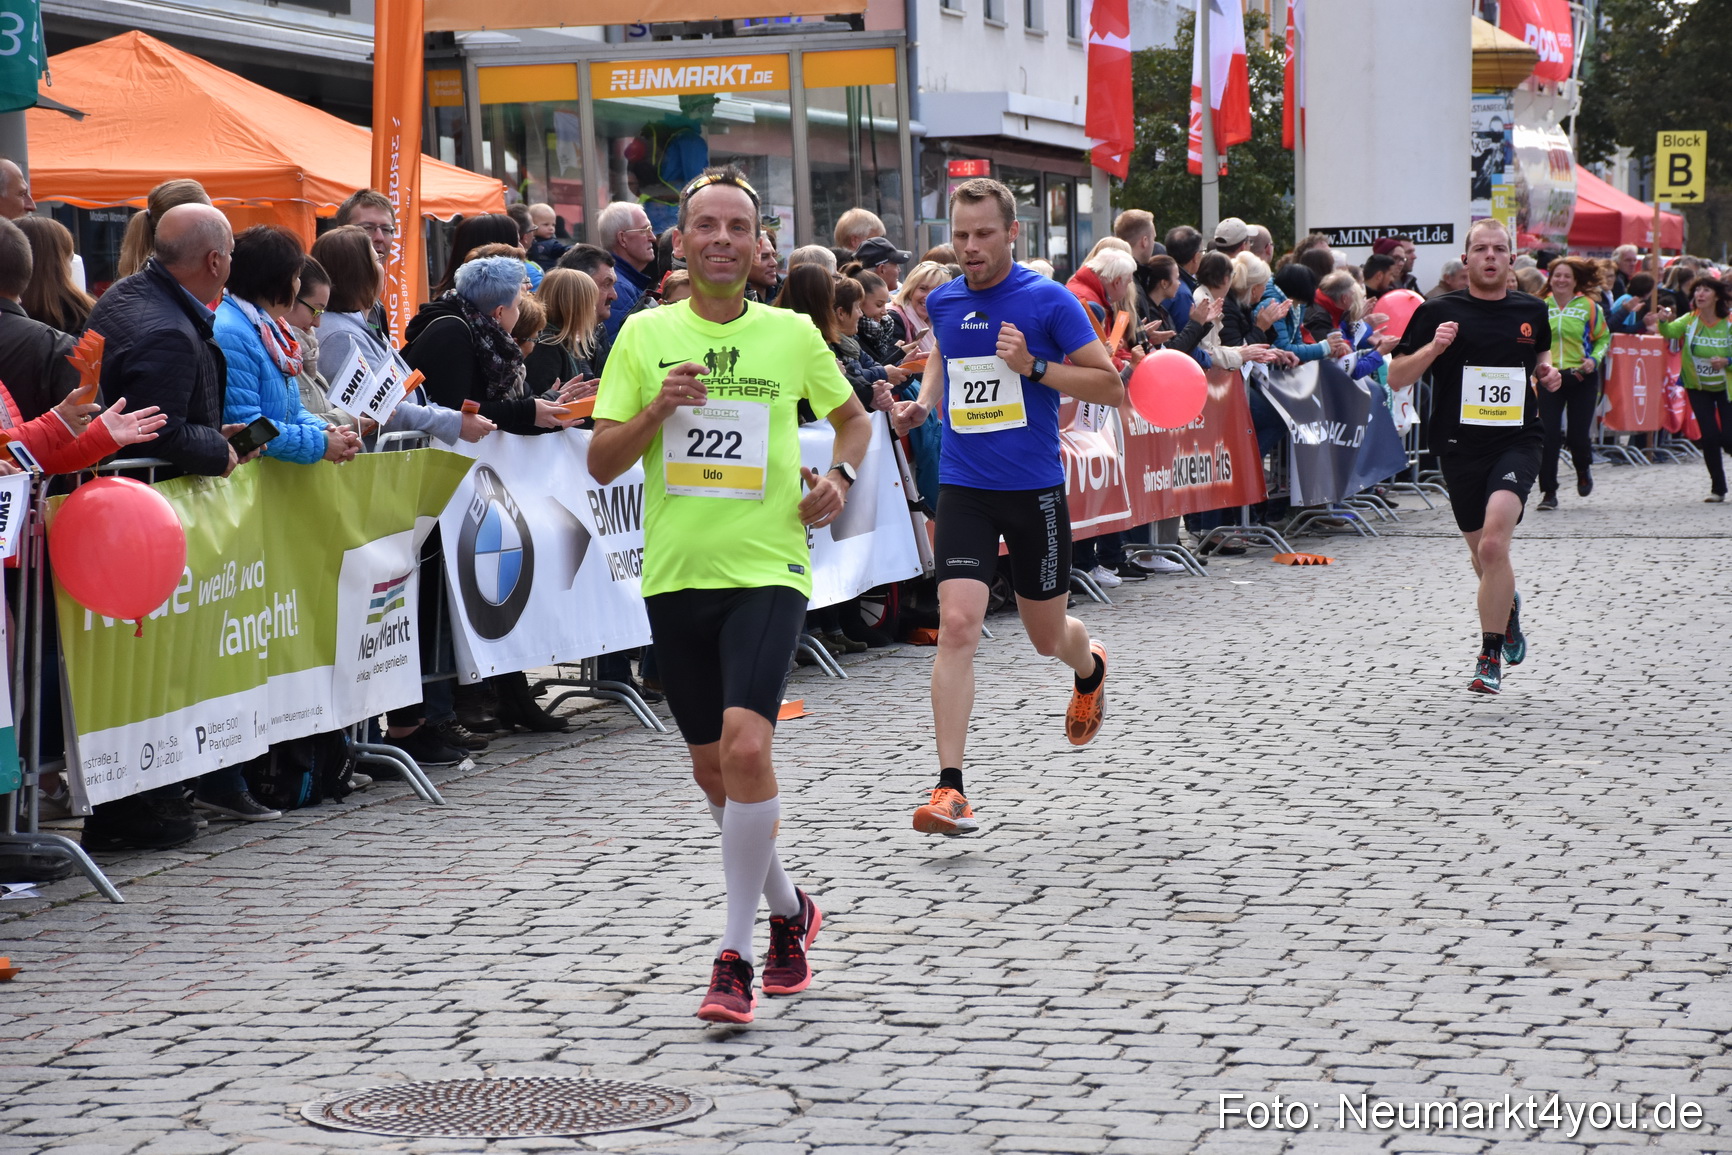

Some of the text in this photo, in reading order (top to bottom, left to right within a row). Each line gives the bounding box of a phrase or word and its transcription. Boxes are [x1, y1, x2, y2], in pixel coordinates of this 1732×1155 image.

[610, 63, 774, 91] RUNMARKT.DE
[1663, 134, 1701, 147] Block
[1668, 153, 1693, 186] B
[960, 321, 989, 330] skinfit
[340, 368, 365, 406] swn
[369, 376, 394, 412] swn
[963, 379, 1001, 404] 227
[1478, 385, 1511, 403] 136
[966, 409, 1004, 421] Christoph
[1478, 408, 1507, 416] Christian
[686, 428, 743, 460] 222
[702, 468, 723, 480] Udo
[586, 483, 644, 537] BMW
[1039, 492, 1058, 591] BIKEIMPERIUM
[198, 561, 238, 606] weiß,
[240, 560, 265, 591] wo
[207, 716, 239, 735] über 500
[209, 733, 242, 751] Parkplätze
